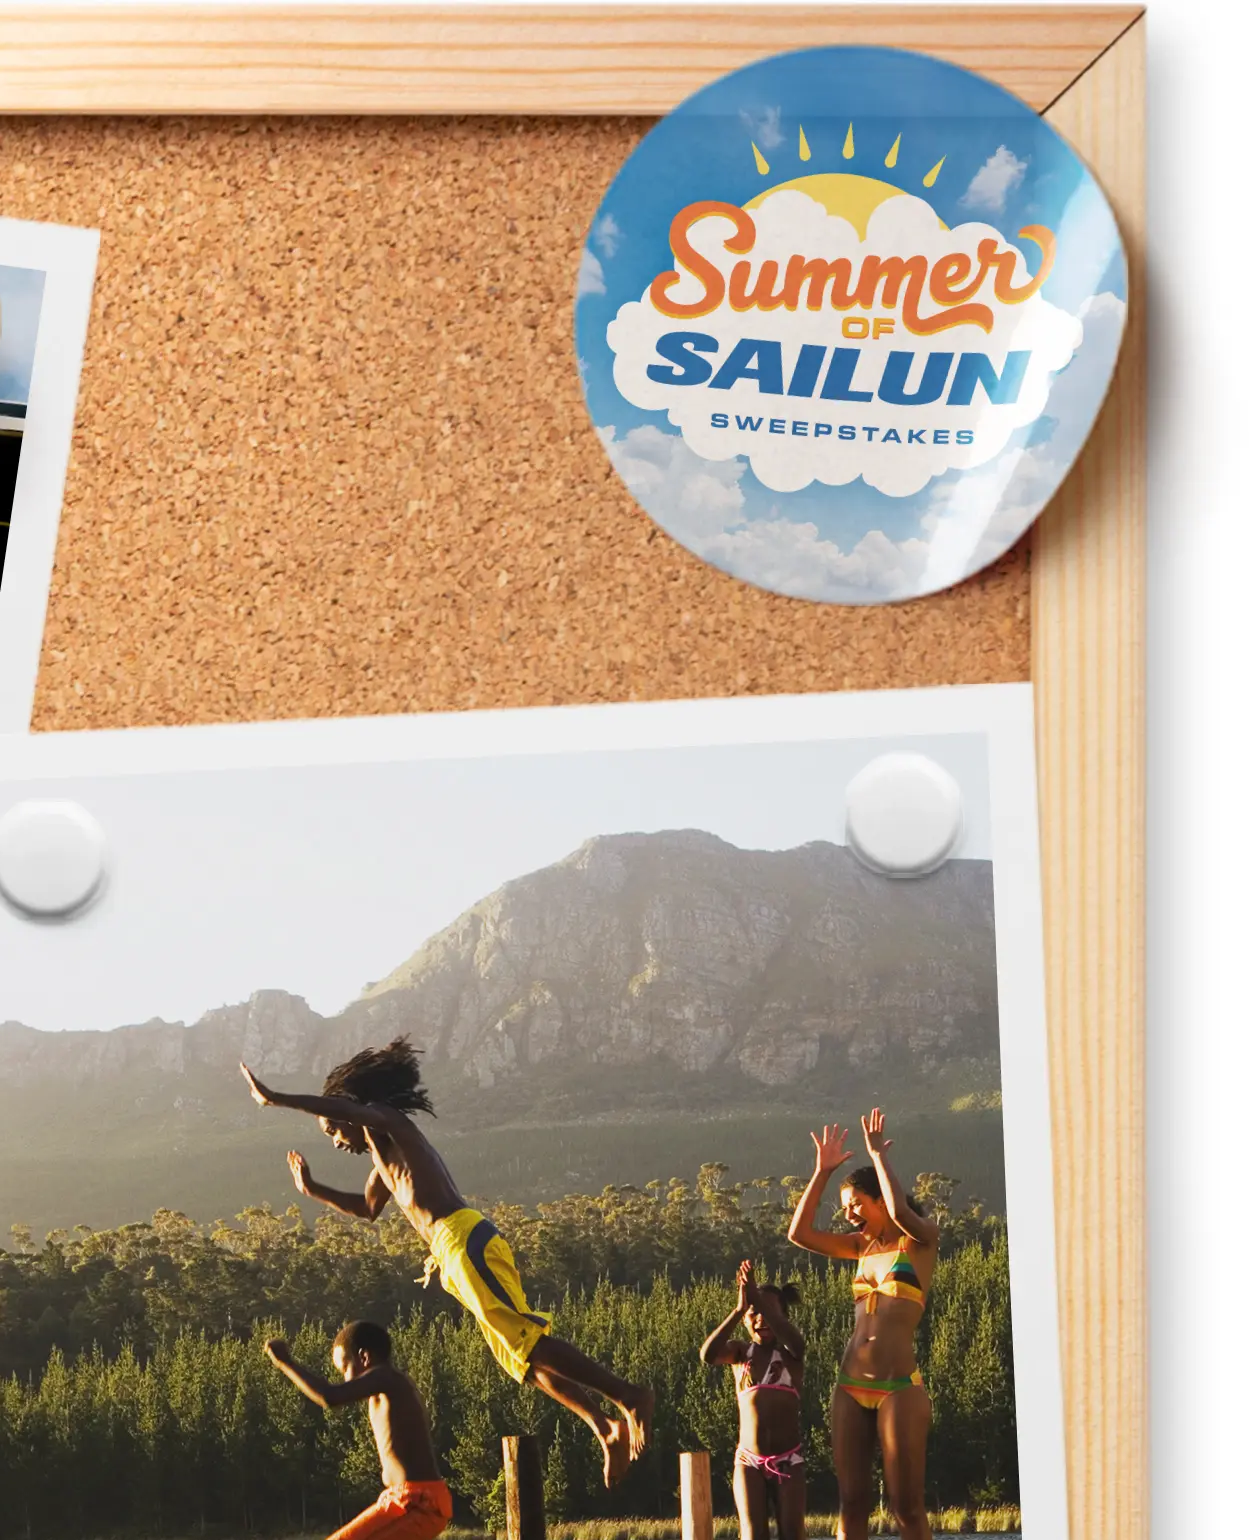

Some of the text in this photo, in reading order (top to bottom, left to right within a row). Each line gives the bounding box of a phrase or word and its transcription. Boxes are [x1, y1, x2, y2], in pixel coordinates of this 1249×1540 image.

[650, 200, 1057, 335] Summer
[841, 316, 896, 340] OF
[646, 331, 1033, 406] SAILUN
[710, 412, 976, 446] SWEEPSTAKES
